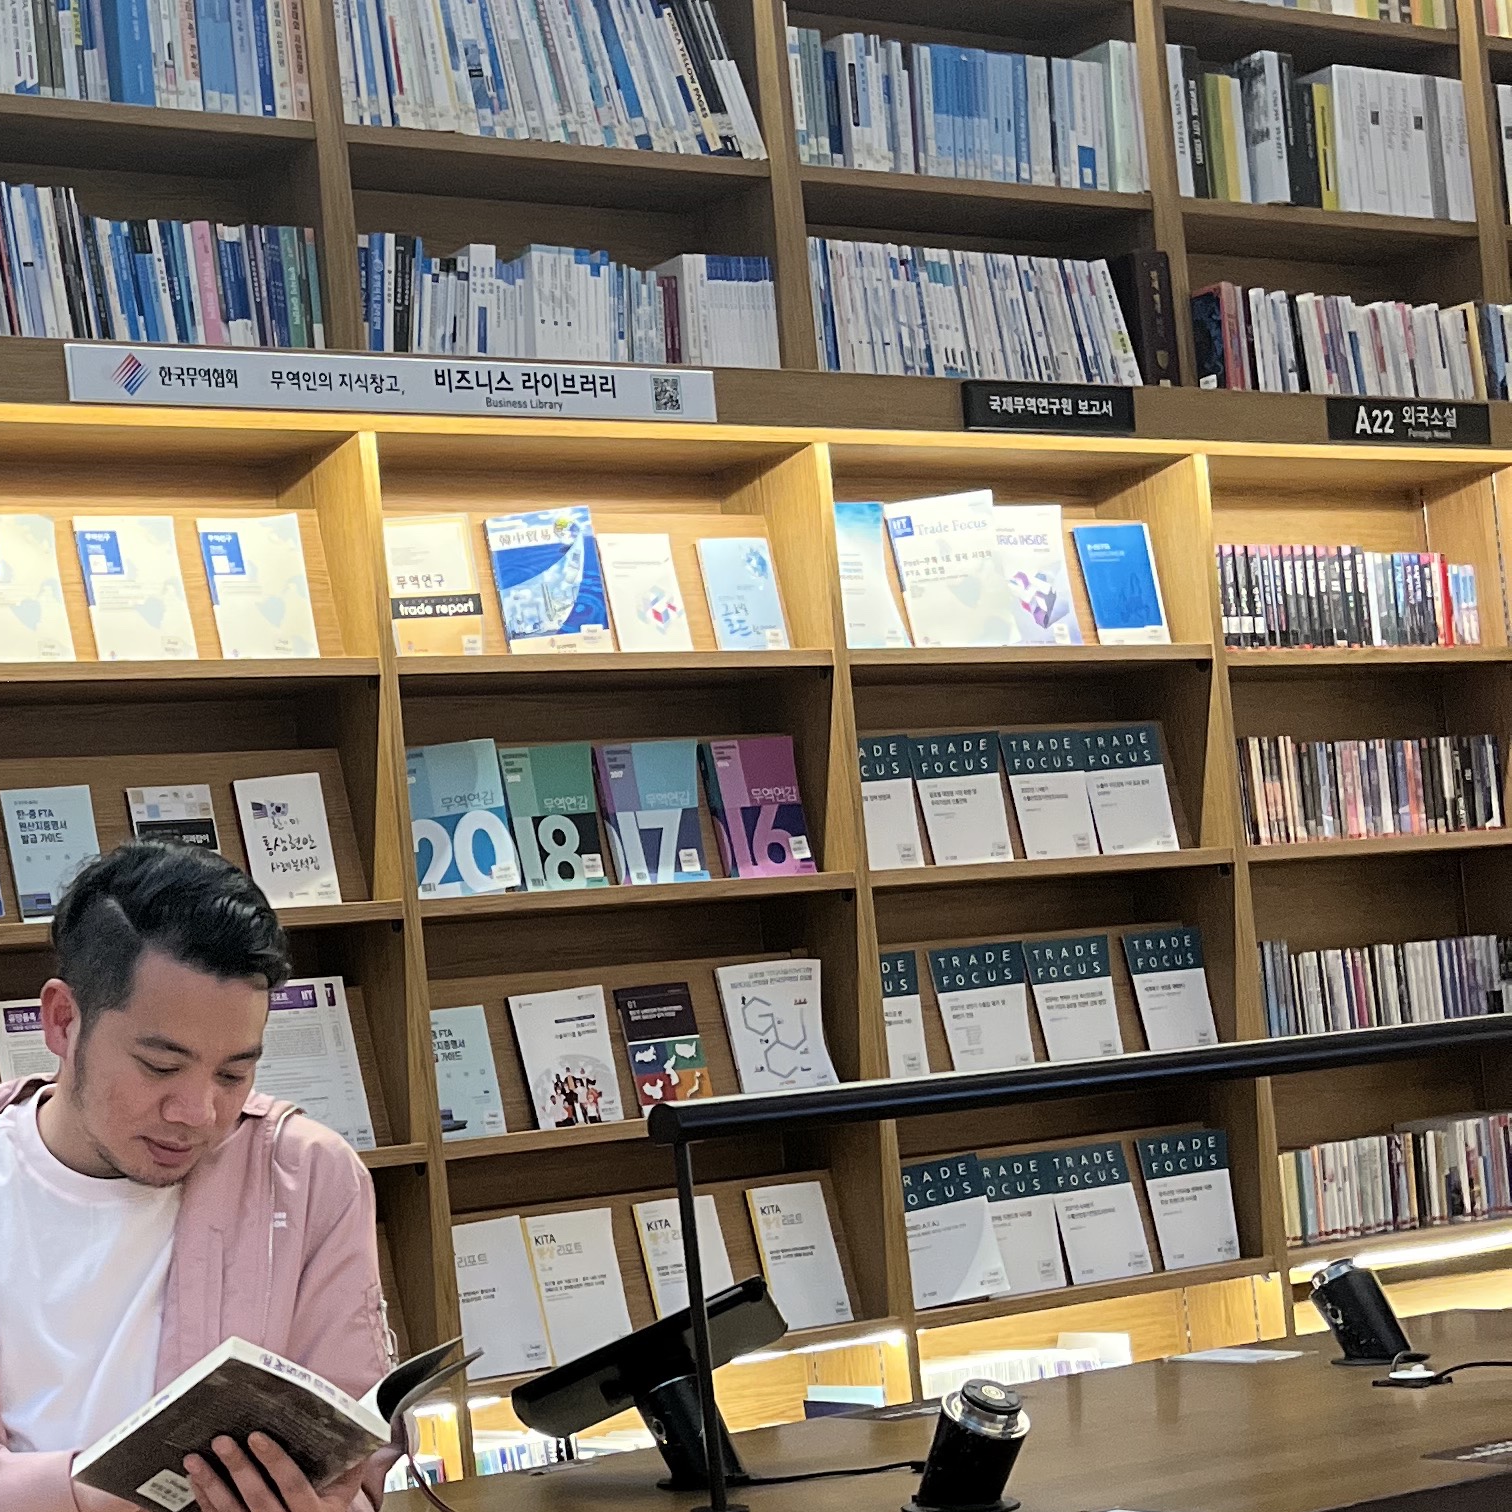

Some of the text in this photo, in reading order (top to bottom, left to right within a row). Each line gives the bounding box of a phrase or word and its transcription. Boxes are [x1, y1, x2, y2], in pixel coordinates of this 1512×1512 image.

[90, 371, 406, 396] 무역인의 지식창고,
[158, 365, 238, 389] 한국무역협회
[434, 368, 617, 400] 비즈니스 라이브러리
[486, 397, 564, 413] Business Library
[988, 395, 1114, 417] 국제무역연구원 보고서
[1356, 406, 1394, 435] A22
[1402, 406, 1457, 429] 외국소설
[915, 518, 988, 536] Trade Focus
[396, 573, 445, 590] 무역연구
[399, 600, 475, 617] trade report
[917, 738, 988, 757] TRADE
[1010, 736, 1072, 753] TRADE
[1083, 731, 1149, 749] TRADE
[921, 756, 989, 774] FOCUS
[1014, 754, 1075, 771] FOCUS
[1088, 749, 1152, 766] FOCUS
[543, 794, 589, 813] 무역연감
[750, 785, 798, 803] 무역연감
[39, 808, 55, 819] FTA
[40, 832, 65, 844] 가이드
[1133, 934, 1192, 951] TRADE
[938, 949, 1011, 969] TRADE
[1032, 943, 1100, 962] TRADE
[1137, 952, 1195, 969] FOCUS
[942, 967, 1013, 987] FOCUS
[1037, 960, 1102, 979] FOCUS
[1148, 1134, 1217, 1155] TRADE
[1052, 1149, 1116, 1170] TRADE
[1151, 1152, 1218, 1173] FOCUS
[902, 1161, 968, 1187] RADE
[1056, 1167, 1120, 1188] FOCUS
[907, 1180, 973, 1206] OCUS
[986, 1177, 1041, 1198] OCUS
[760, 1203, 782, 1216] KITA
[646, 1218, 672, 1232] KITA
[534, 1233, 557, 1247] KITA
